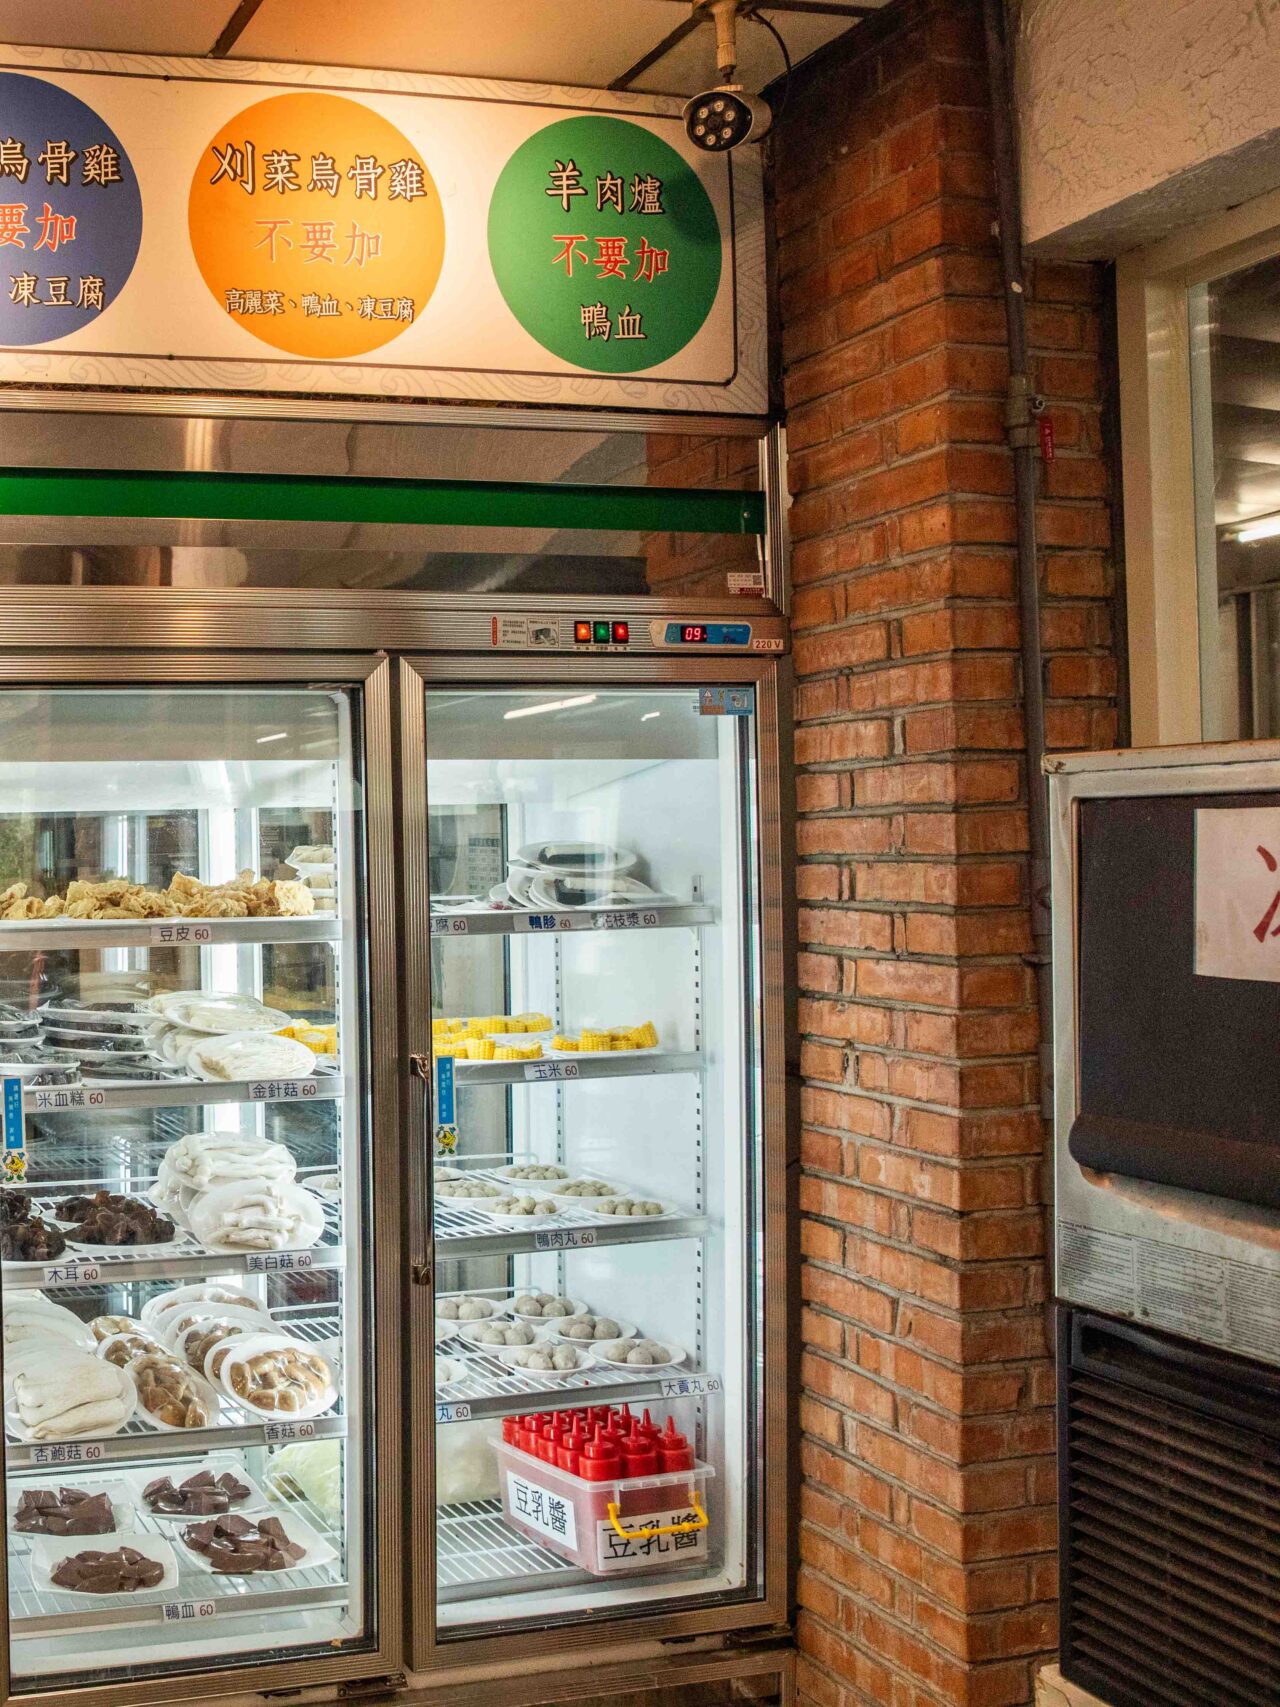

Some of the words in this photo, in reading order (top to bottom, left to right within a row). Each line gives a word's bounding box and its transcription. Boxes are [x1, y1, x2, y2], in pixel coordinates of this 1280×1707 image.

[210, 140, 427, 202] 刈菜烏骨雞
[545, 158, 665, 216] 羊肉爐
[253, 217, 382, 268] 不要加
[550, 233, 669, 283] 不要加
[578, 300, 646, 343] 鴨血
[755, 640, 771, 649] 220
[774, 640, 781, 649] V
[453, 919, 466, 931] 60
[560, 918, 571, 929] 60
[644, 913, 656, 925] 60
[159, 926, 190, 942] 豆皮
[195, 928, 209, 940] 60
[533, 1063, 562, 1079] 玉米
[565, 1065, 577, 1076] 60
[252, 1082, 298, 1099] 金針菇
[302, 1084, 316, 1096] 60
[38, 1091, 85, 1108] 米血糕
[89, 1092, 103, 1104] 60
[536, 1231, 578, 1248] 鴨肉丸
[581, 1233, 594, 1244] 60
[249, 1254, 294, 1271] 美白菇
[298, 1255, 312, 1267] 60
[48, 1265, 79, 1283] 木耳
[83, 1268, 98, 1280] 60
[664, 1378, 705, 1396] 大貢丸
[707, 1380, 720, 1391] 60
[455, 1406, 469, 1418] 60
[265, 1423, 296, 1440] 香菇
[299, 1424, 313, 1436] 60
[34, 1445, 82, 1462] 杏鮑菇
[86, 1446, 101, 1458] 60
[512, 1479, 568, 1536] 豆乳醬
[602, 1512, 701, 1560] 豆乳醬
[165, 1602, 195, 1620] 鴨血
[199, 1604, 213, 1616] 60
